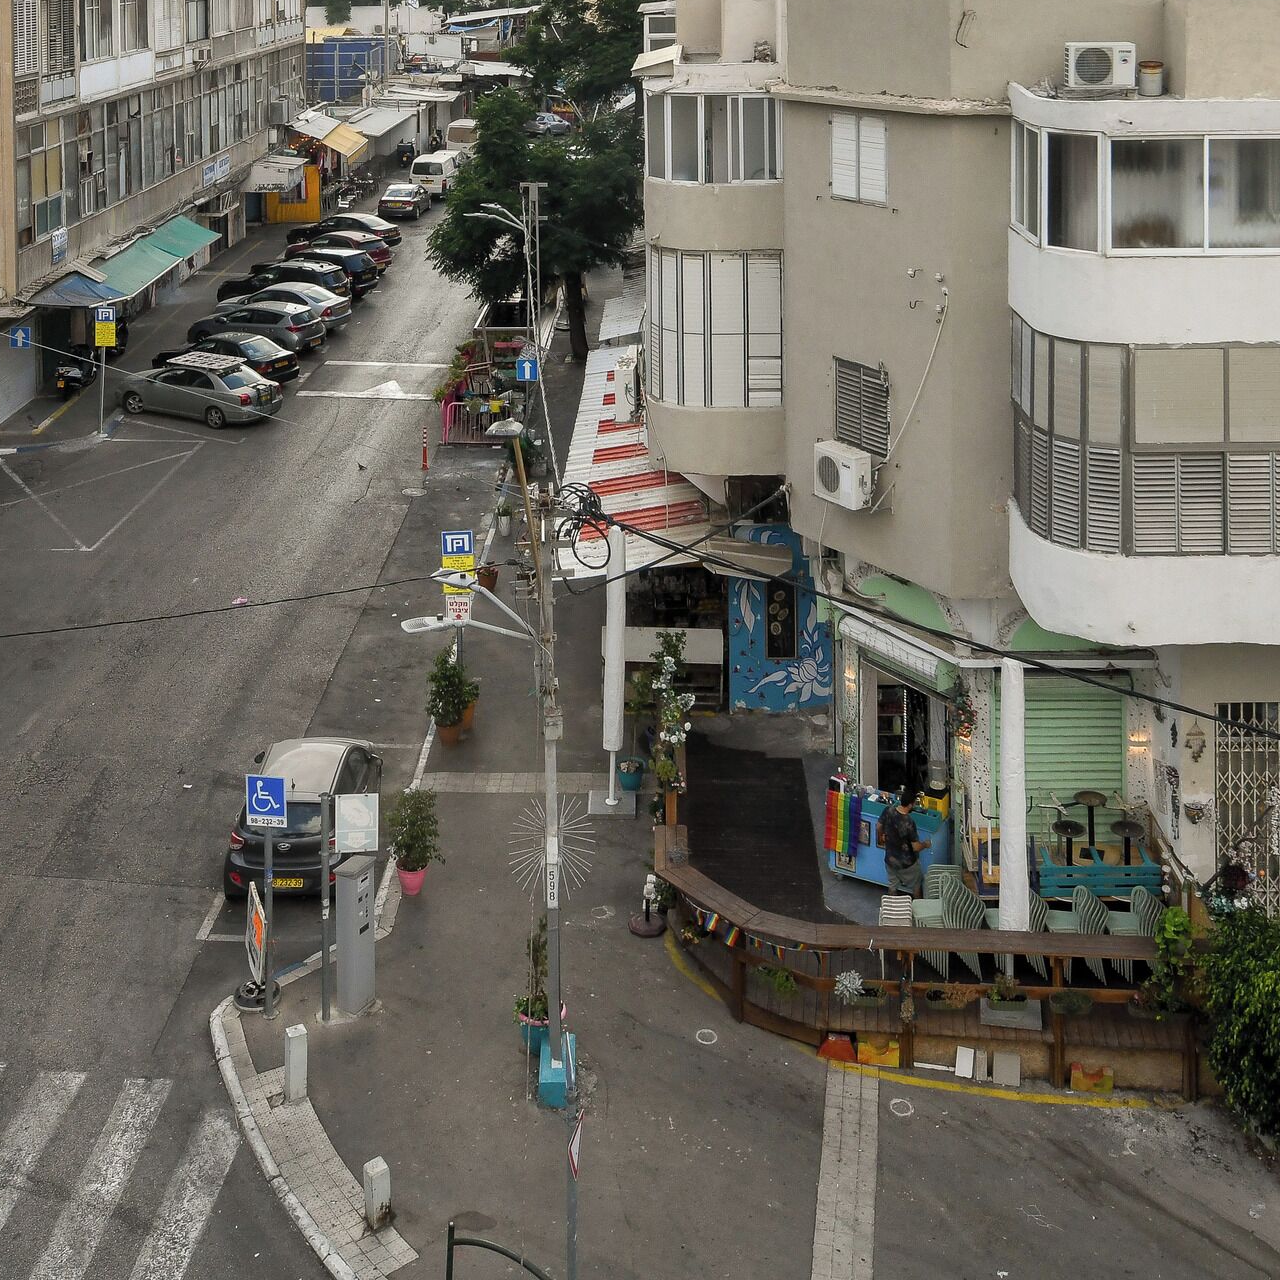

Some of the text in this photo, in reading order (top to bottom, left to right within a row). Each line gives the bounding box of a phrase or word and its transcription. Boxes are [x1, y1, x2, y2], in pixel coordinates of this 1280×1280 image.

[449, 600, 468, 608] מקלט
[250, 817, 285, 825] 98-232-39
[548, 870, 556, 901] 598
